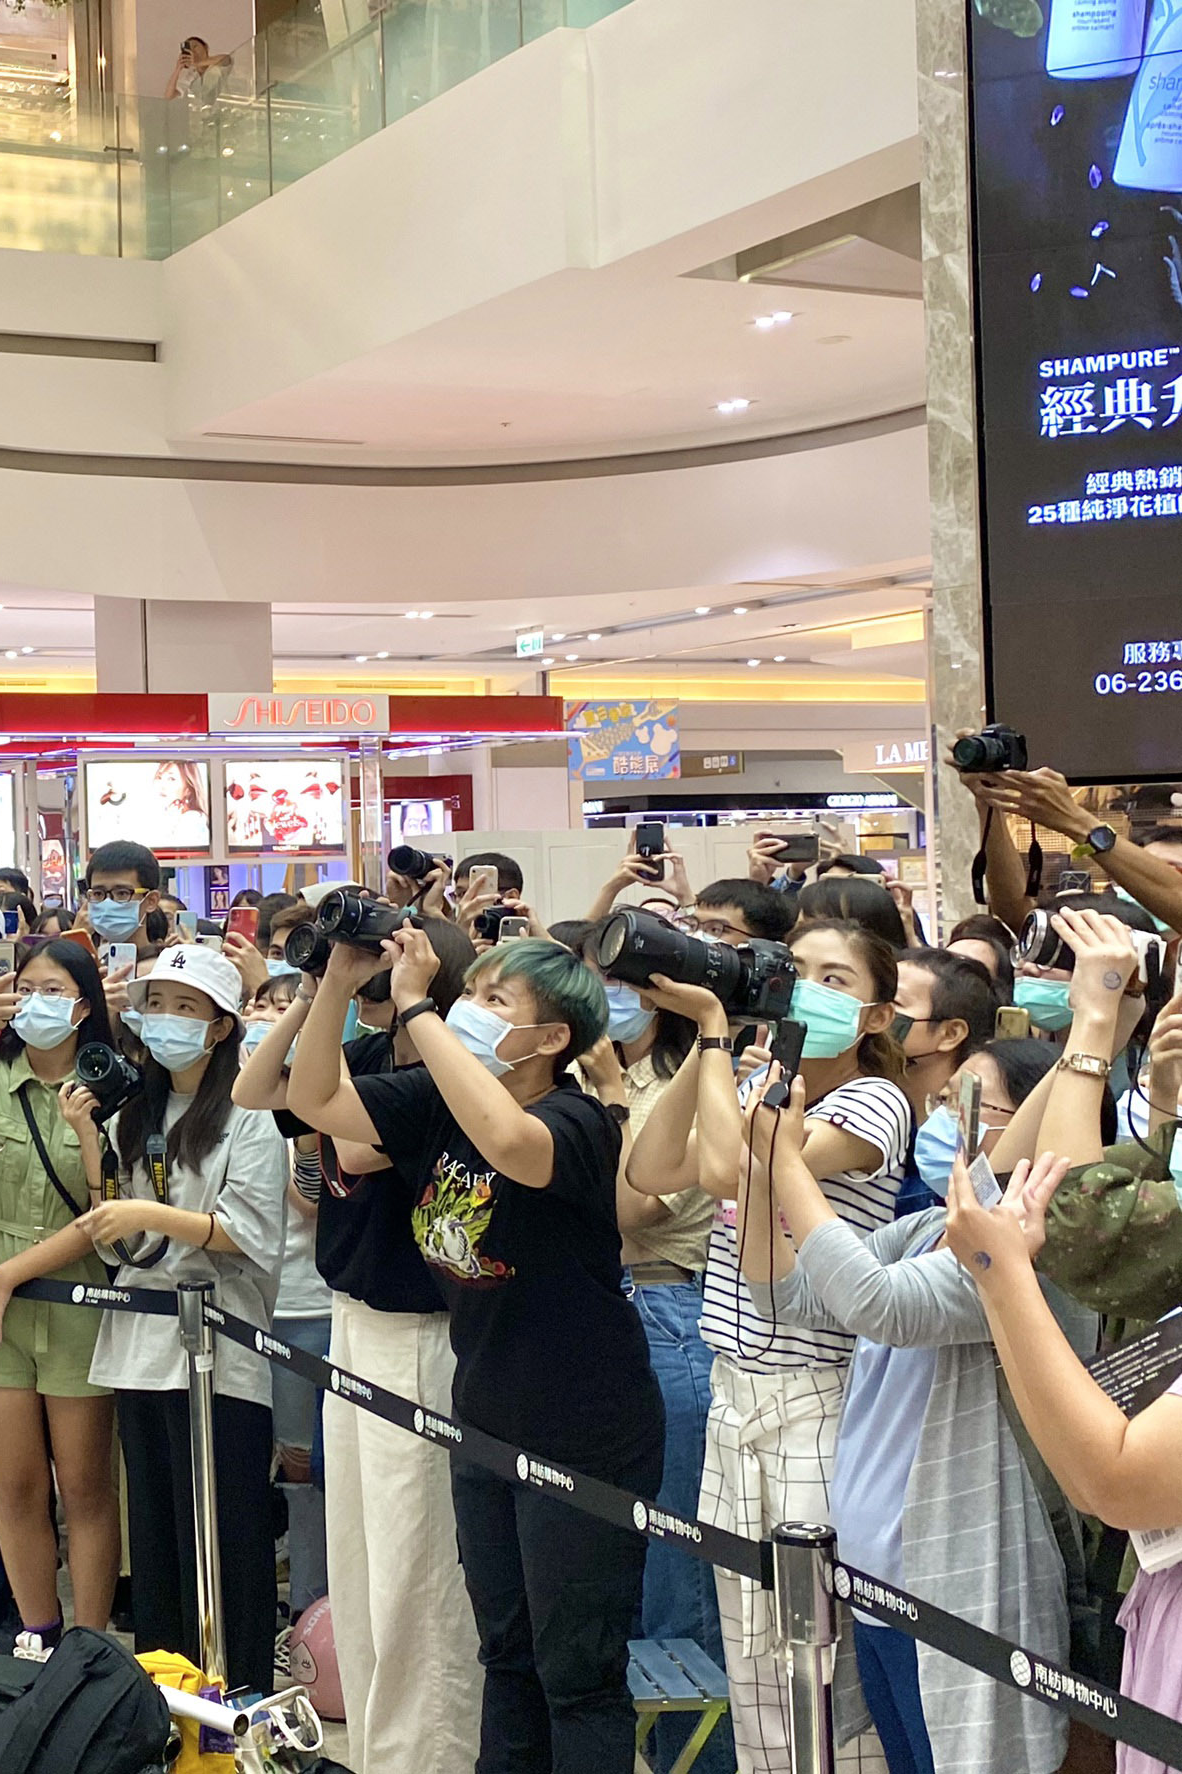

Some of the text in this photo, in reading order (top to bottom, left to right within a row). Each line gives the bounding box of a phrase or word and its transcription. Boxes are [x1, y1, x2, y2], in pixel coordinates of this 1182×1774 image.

[1028, 493, 1182, 524] 25種純淨花植
[1095, 670, 1182, 695] 06-236
[223, 696, 377, 727] SHISEIDO
[875, 744, 902, 765] LA
[170, 951, 187, 969] LA
[153, 1162, 165, 1196] Nikon
[853, 1576, 918, 1621] 南紡購物中心
[1034, 1662, 1117, 1718] 南紡購物中心
